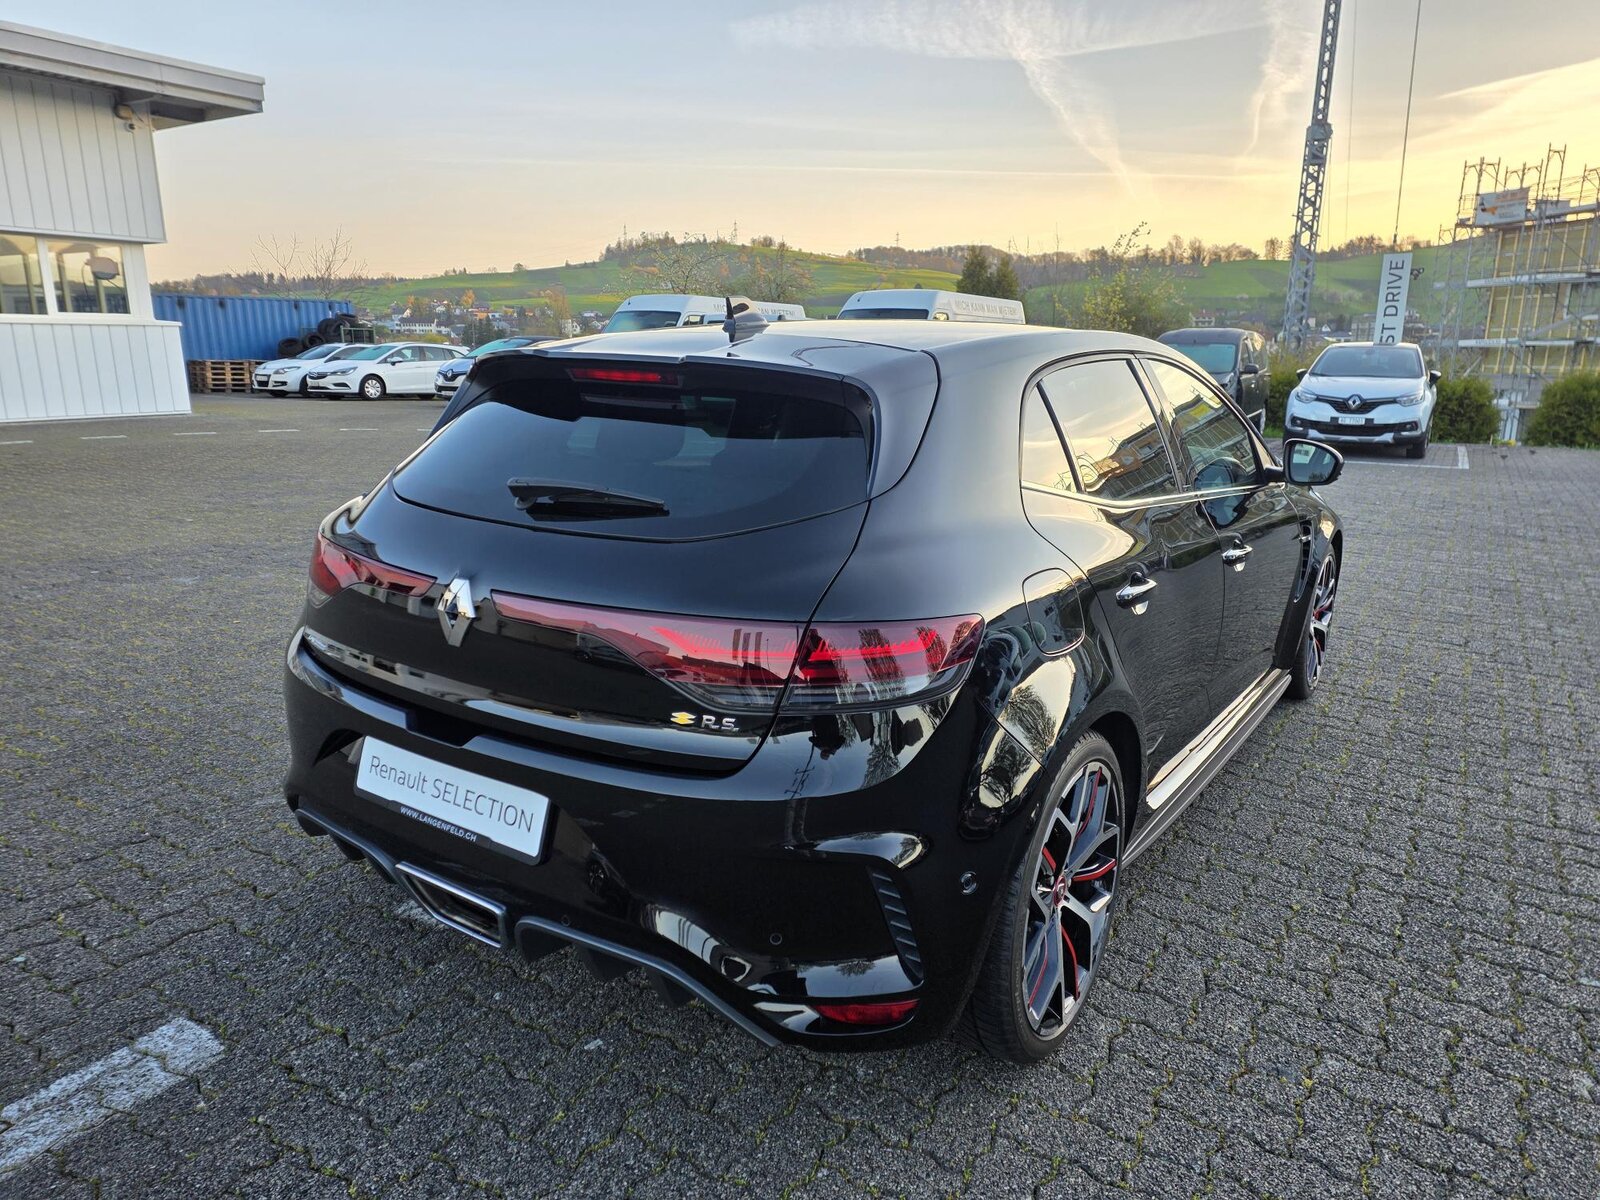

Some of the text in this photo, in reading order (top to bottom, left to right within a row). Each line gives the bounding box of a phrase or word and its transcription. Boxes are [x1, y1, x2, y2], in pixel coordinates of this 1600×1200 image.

[1379, 260, 1405, 344] ST DRIVE
[369, 755, 534, 833] Renault SELECTION
[400, 805, 477, 843] WWW.LANGENFELD.CH
